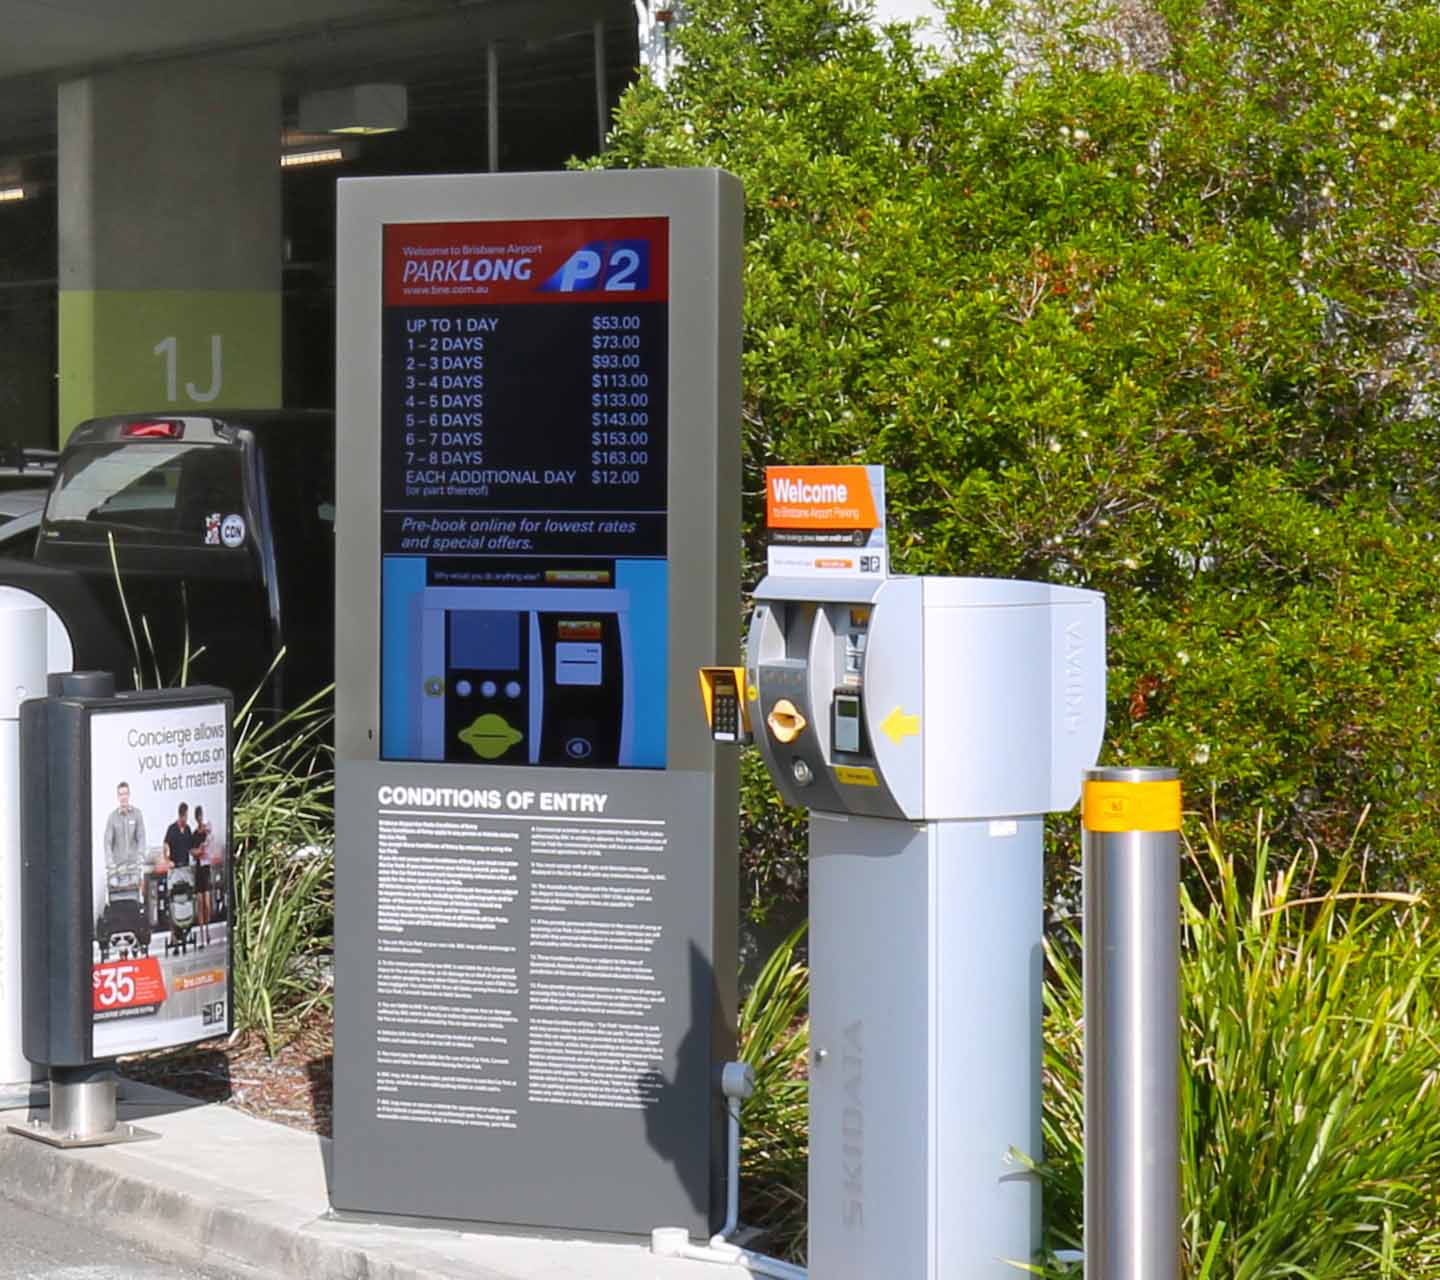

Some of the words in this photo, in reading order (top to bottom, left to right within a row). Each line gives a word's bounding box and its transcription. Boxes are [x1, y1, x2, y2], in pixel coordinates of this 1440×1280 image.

[402, 245, 449, 256] Welcome
[450, 246, 461, 255] to
[462, 244, 506, 255] Brisbane
[507, 243, 543, 255] Airport
[402, 258, 532, 282] PARKLONG
[406, 319, 427, 333] UP
[431, 318, 451, 332] TO
[455, 318, 463, 332] 1
[467, 317, 499, 332] DAY
[591, 315, 641, 330] $53.00
[408, 338, 414, 351] 1
[430, 338, 438, 351] 2
[442, 337, 483, 351] DAYS
[591, 335, 641, 350] $73.00
[153, 334, 222, 401] 1J
[406, 357, 415, 370] 2
[430, 357, 438, 370] 3
[442, 356, 483, 370] DAYS
[591, 354, 641, 369] $93.00
[406, 376, 415, 389] 3
[430, 376, 438, 389] 4
[442, 375, 483, 389] DAYS
[591, 373, 649, 388] $113.00
[406, 395, 415, 408] 4
[430, 395, 438, 408] 5
[442, 394, 483, 408] DAYS
[591, 393, 649, 407] $133.00
[406, 414, 415, 427] 5
[430, 414, 438, 427] 6
[442, 413, 483, 427] DAYS
[591, 412, 649, 427] $143.00
[406, 433, 415, 446] 6
[430, 433, 438, 446] 7
[442, 432, 483, 446] DAYS
[591, 431, 649, 446] $153.00
[406, 452, 415, 465] 7
[430, 452, 438, 465] 8
[442, 451, 483, 465] DAYS
[591, 450, 649, 465] $163.00
[406, 470, 446, 484] EACH
[450, 470, 540, 484] ADDITIONAL
[544, 470, 577, 484] DAY
[591, 470, 640, 485] $12.00
[772, 478, 848, 503] Welcome
[401, 517, 466, 532] Pre-book
[470, 518, 516, 533] online
[519, 518, 541, 533] for
[544, 519, 593, 533] lowest
[596, 520, 637, 534] rates
[401, 535, 429, 549] and
[432, 535, 484, 551] special
[487, 536, 534, 550] offers.
[127, 726, 192, 748] Concierge
[193, 723, 225, 741] allows
[138, 755, 162, 774] you
[166, 752, 178, 767] to
[181, 748, 210, 766] focus
[212, 747, 225, 761] on
[152, 773, 183, 792] what
[186, 770, 225, 788] matters
[378, 786, 502, 810] CONDITIONS
[506, 791, 535, 811] OF
[540, 792, 608, 813] ENTRY
[842, 1019, 864, 1228] SKIDATA
